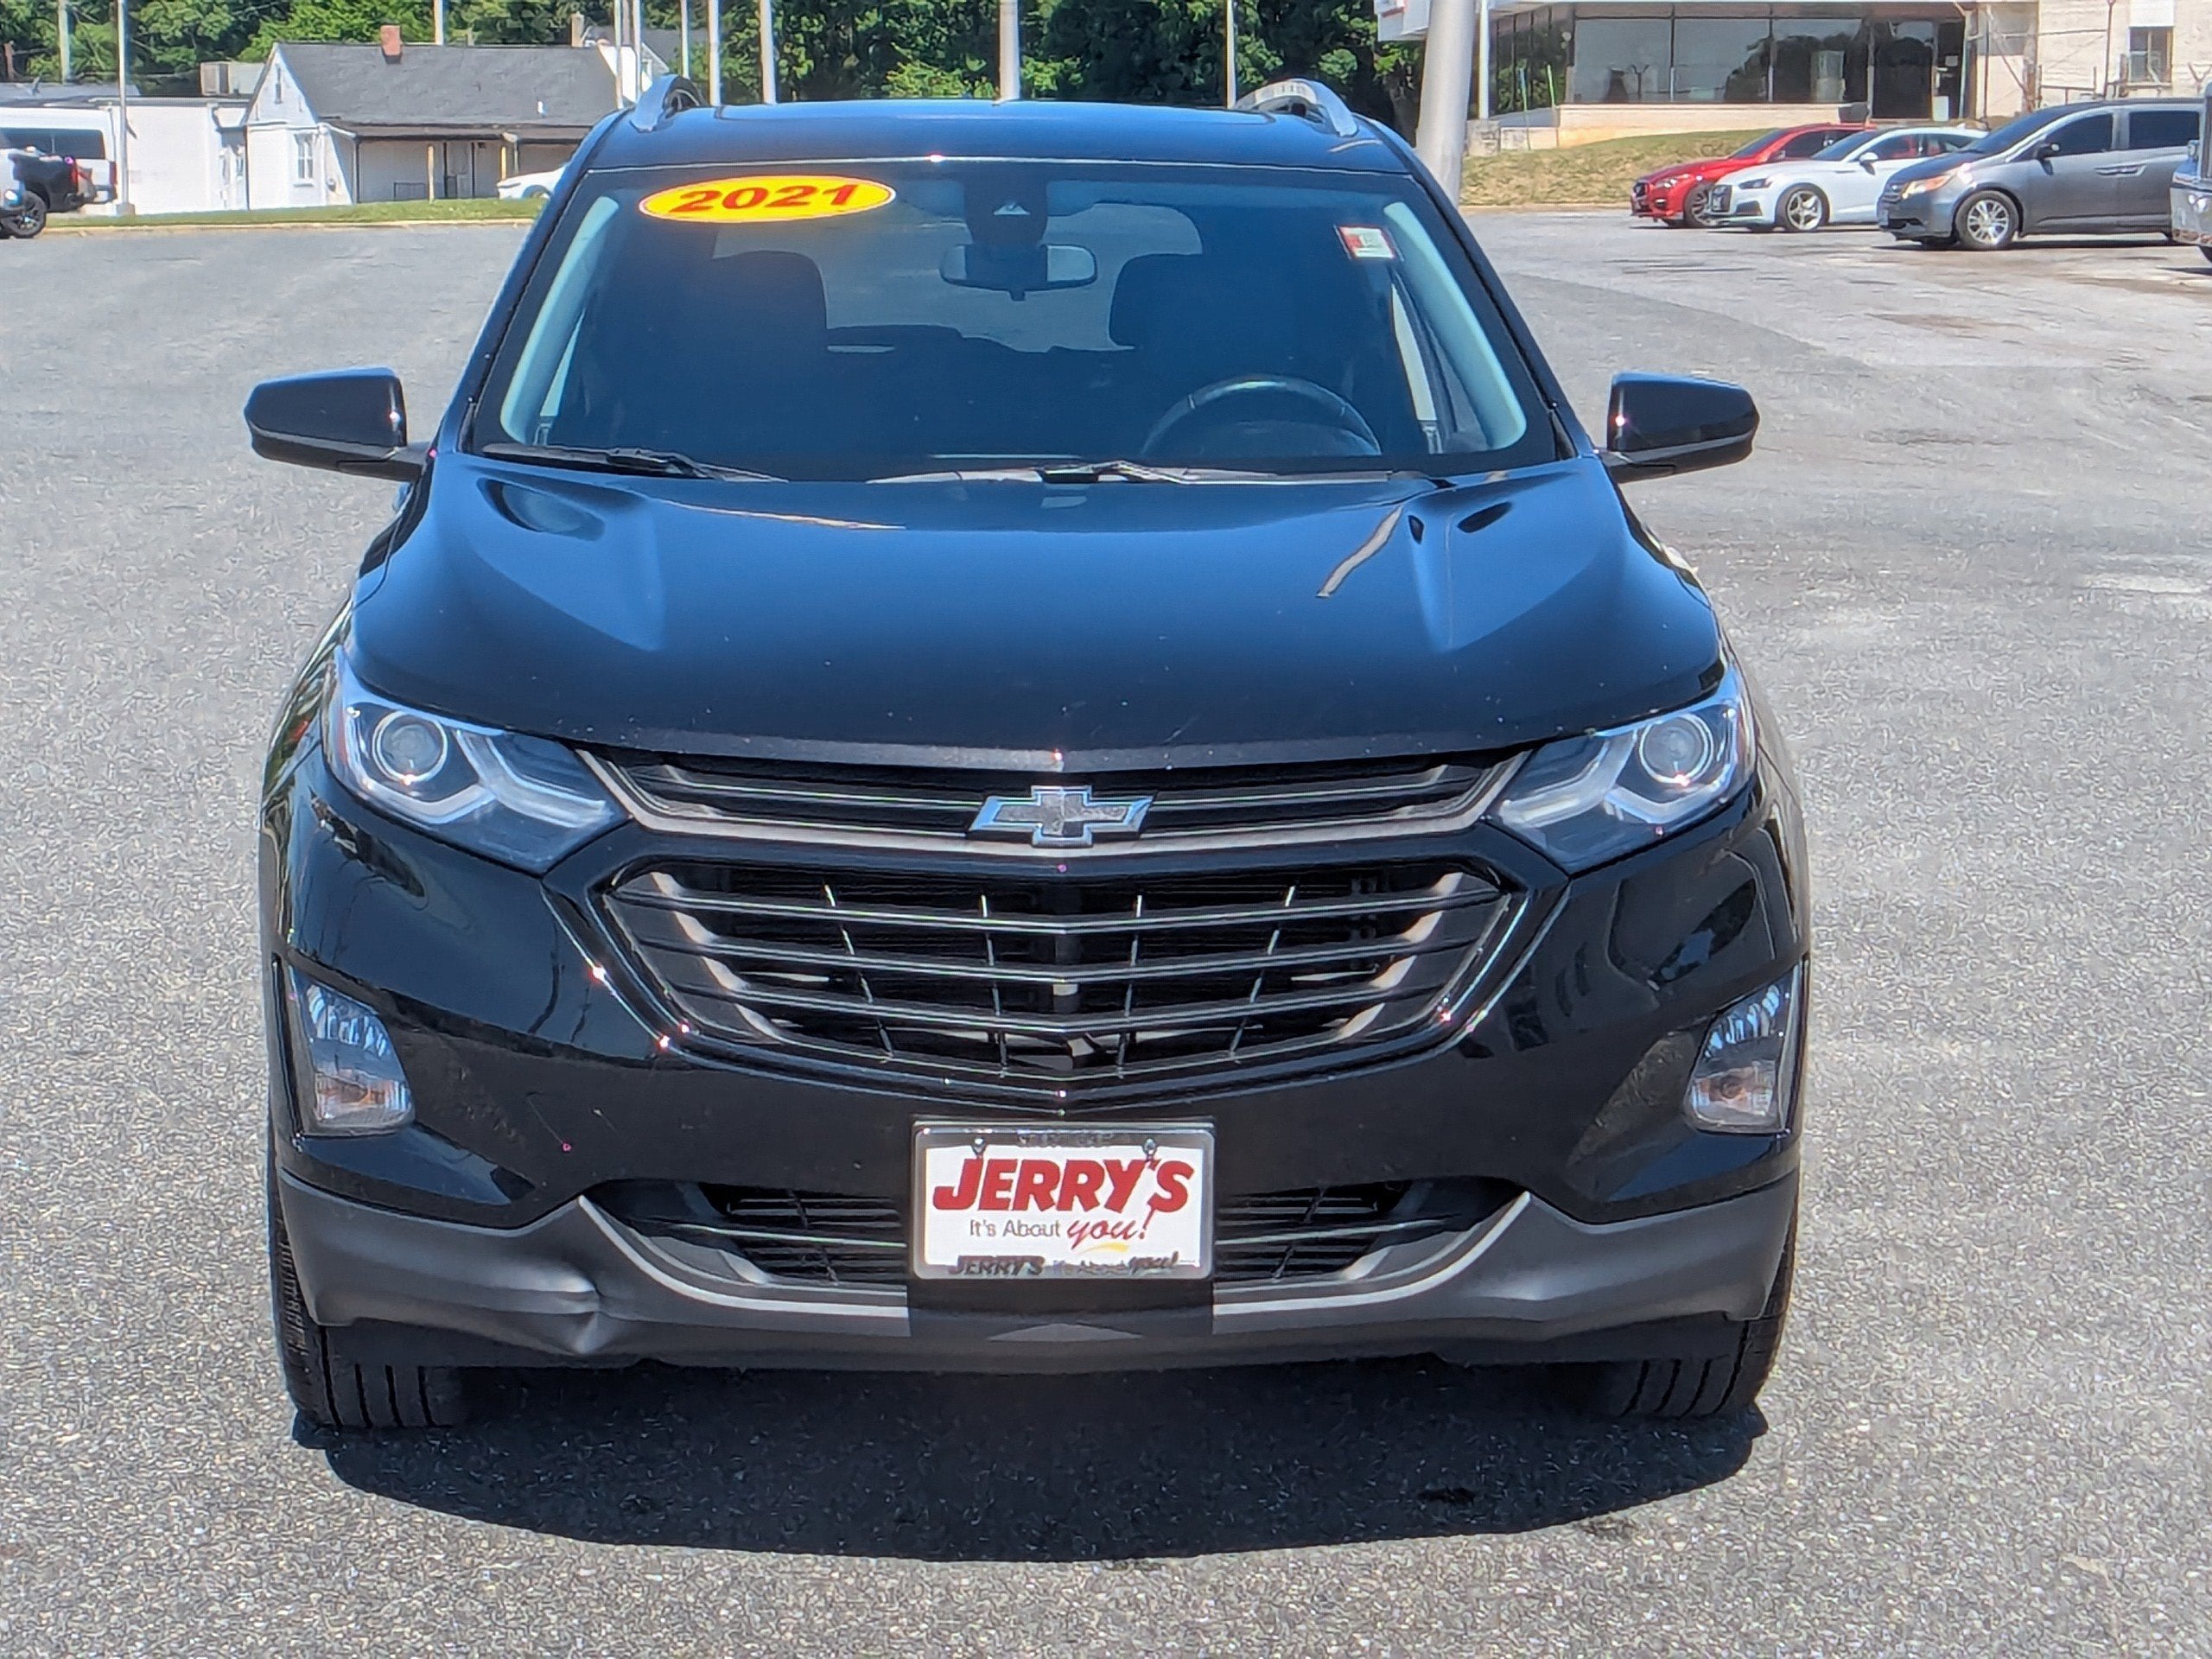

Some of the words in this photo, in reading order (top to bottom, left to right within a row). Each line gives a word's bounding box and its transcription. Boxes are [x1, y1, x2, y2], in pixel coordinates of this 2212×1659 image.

[669, 183, 857, 213] 2021
[932, 1158, 1195, 1213] JERRY'S
[969, 1218, 996, 1237] It's
[1002, 1218, 1061, 1237] About
[1066, 1210, 1156, 1250] you!
